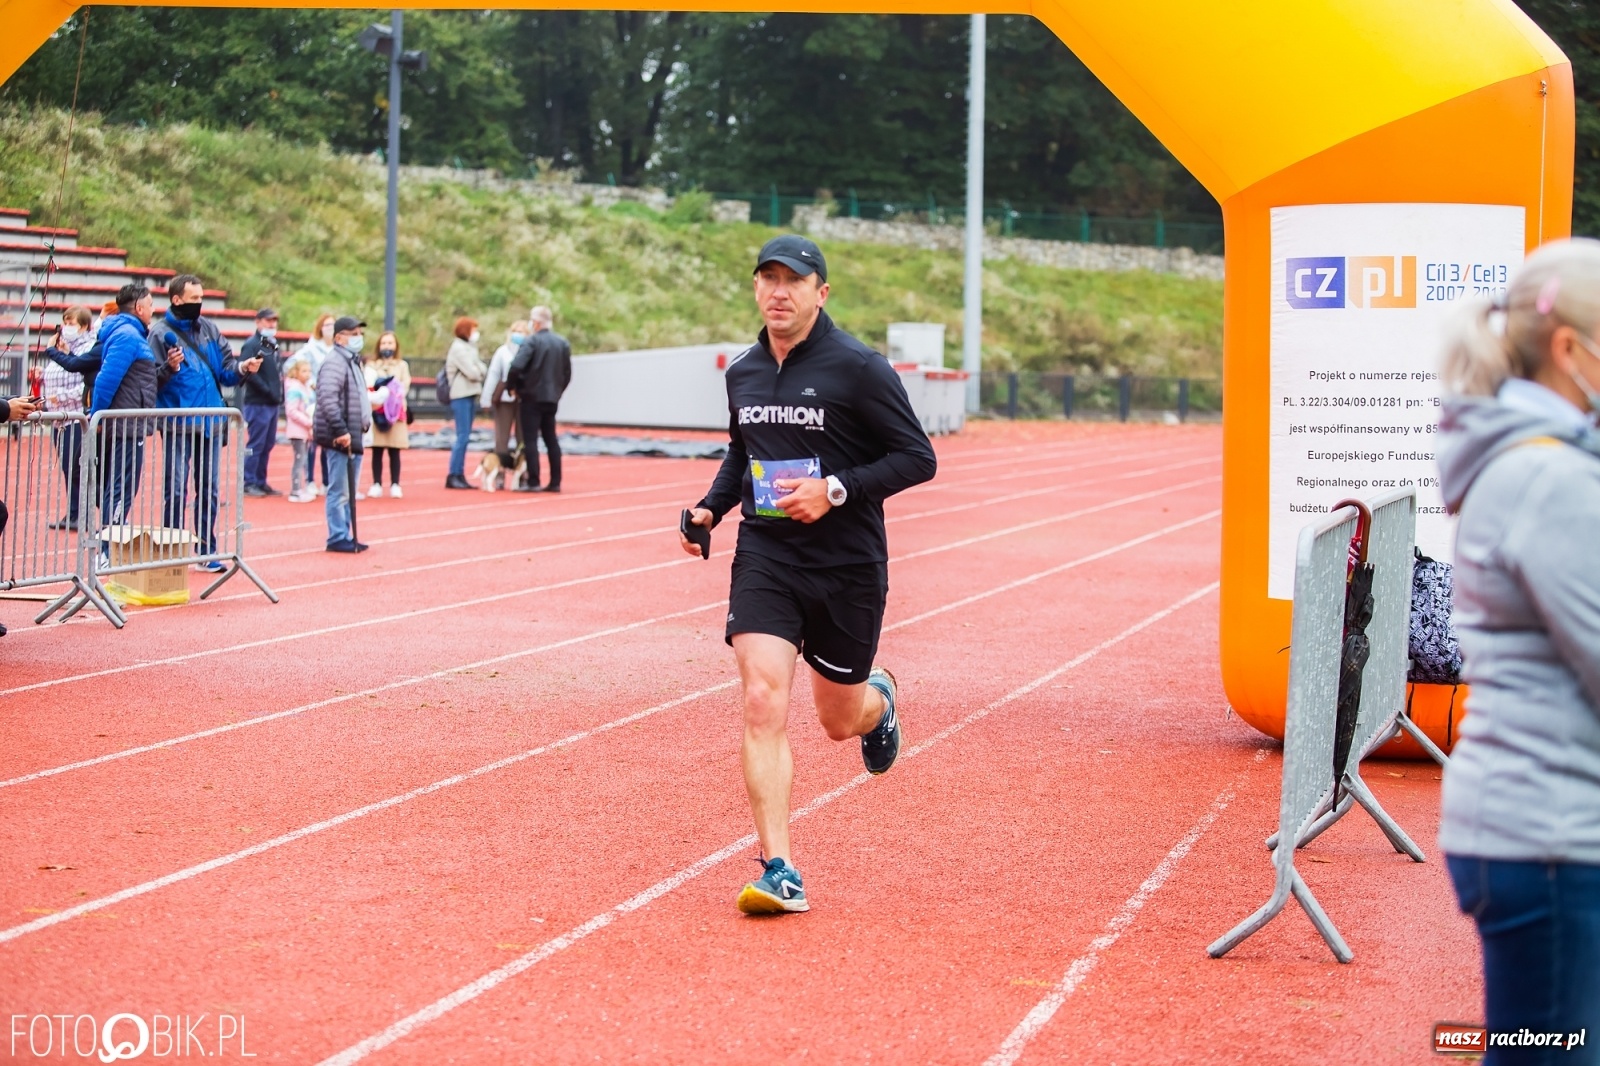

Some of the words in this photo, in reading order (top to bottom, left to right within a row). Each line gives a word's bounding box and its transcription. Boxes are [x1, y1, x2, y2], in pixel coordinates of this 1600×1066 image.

[1295, 267, 1338, 298] cz
[1362, 256, 1403, 308] pl
[1309, 371, 1346, 382] Projekt
[1283, 397, 1297, 407] PL.
[1300, 397, 1401, 407] 3.22/3.304/09.01281
[1406, 399, 1423, 409] pn:
[1428, 397, 1440, 407] “B
[738, 405, 825, 426] DECATHLON
[1289, 424, 1307, 435] jest
[1309, 424, 1410, 436] współfinansowany
[1307, 450, 1384, 462] Europejskiego
[1297, 477, 1368, 489] Regionalnego
[1372, 480, 1395, 488] oraz
[1417, 477, 1440, 488] 10%
[1289, 503, 1328, 513] budżetu
